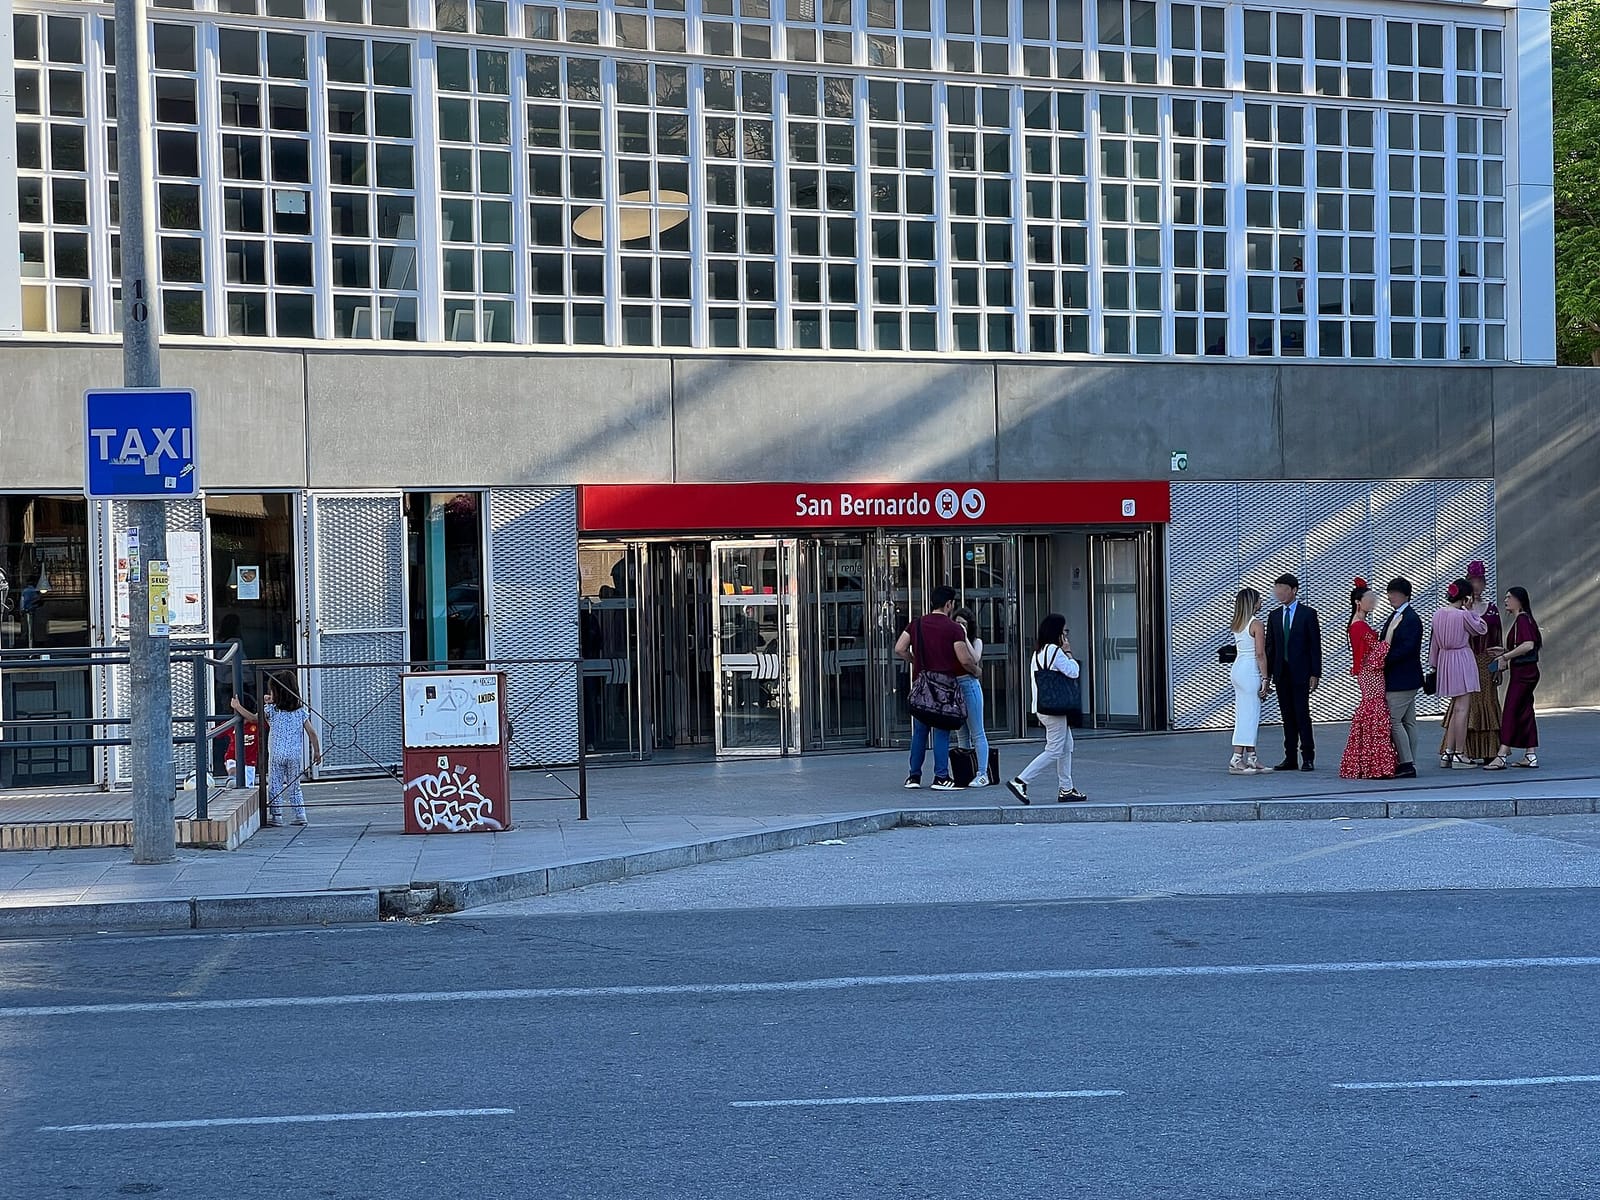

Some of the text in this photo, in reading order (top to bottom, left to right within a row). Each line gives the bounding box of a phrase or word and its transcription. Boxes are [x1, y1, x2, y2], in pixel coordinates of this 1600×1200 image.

[90, 428, 191, 460] TAXI
[795, 491, 931, 517] San Bernardo
[841, 560, 862, 575] renfe
